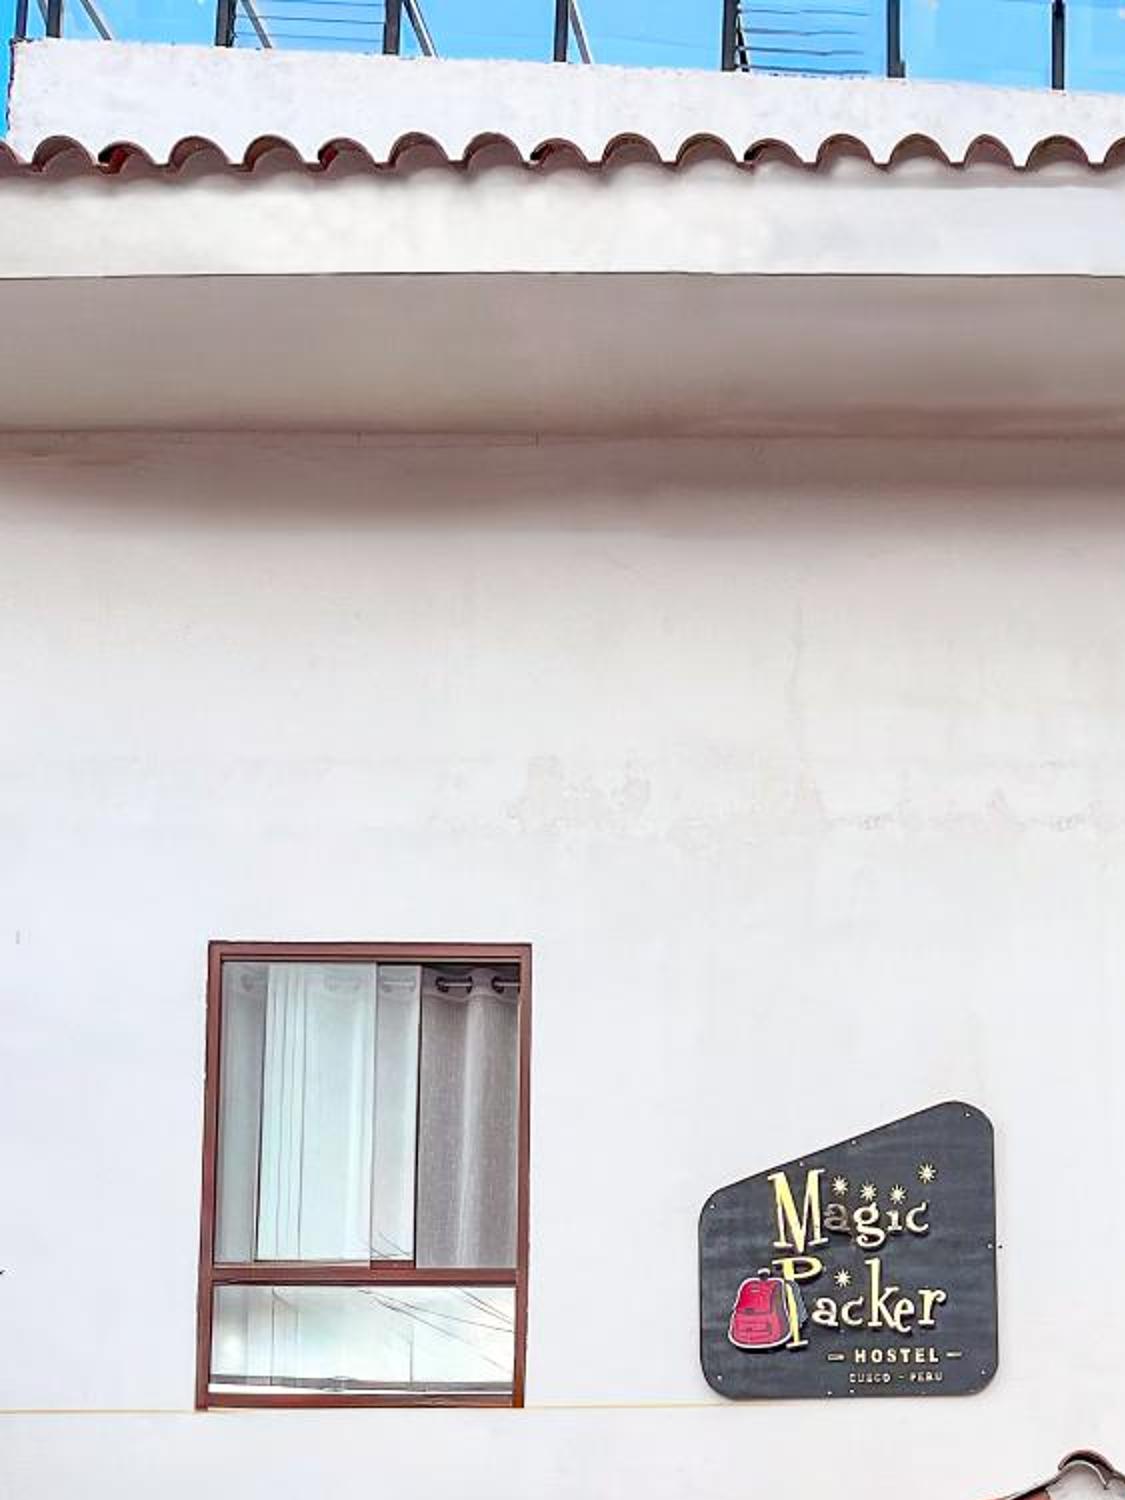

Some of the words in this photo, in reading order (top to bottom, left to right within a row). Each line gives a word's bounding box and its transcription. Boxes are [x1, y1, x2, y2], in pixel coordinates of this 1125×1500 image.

[767, 1168, 930, 1253] Magic
[771, 1256, 947, 1348] Packer
[855, 1347, 939, 1363] HOSTEL
